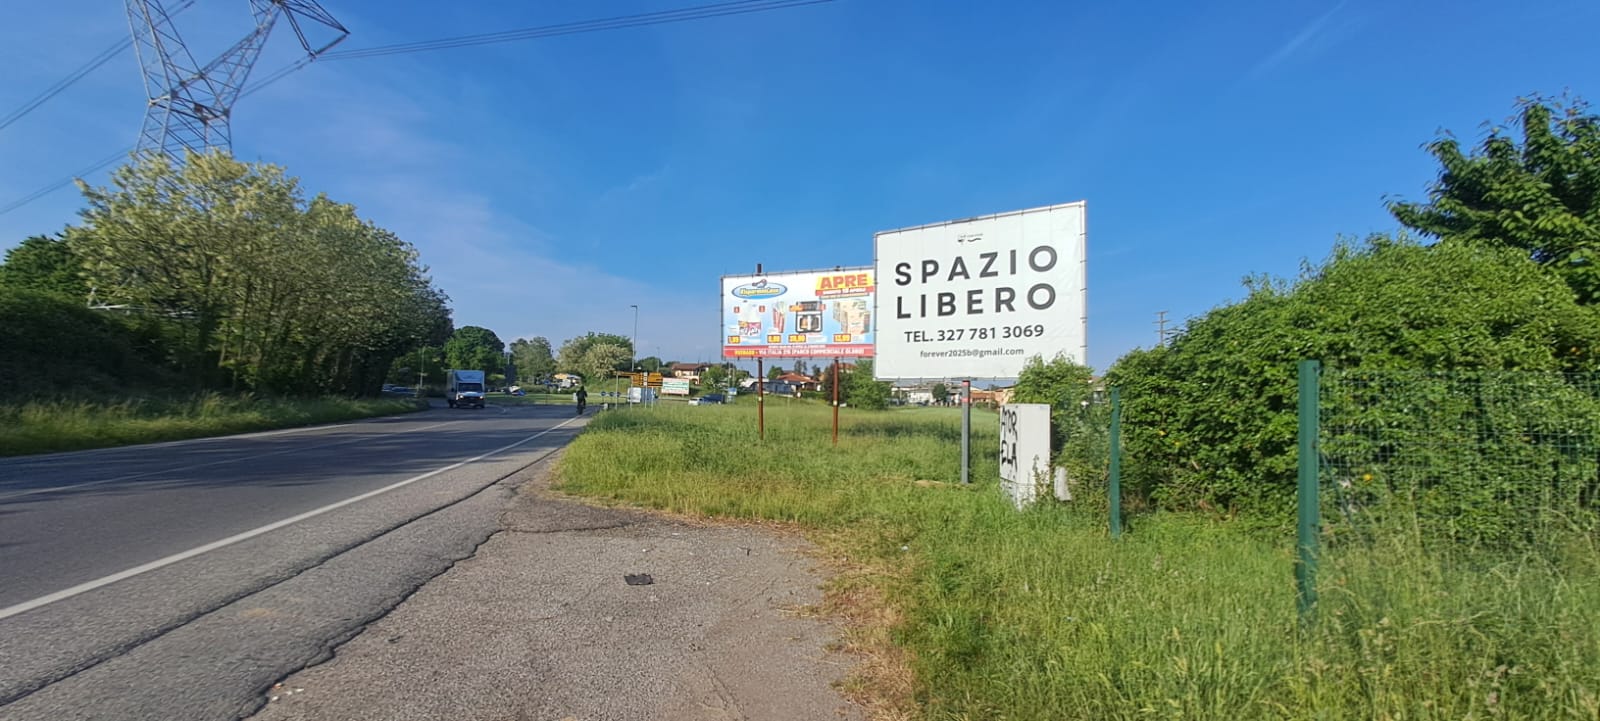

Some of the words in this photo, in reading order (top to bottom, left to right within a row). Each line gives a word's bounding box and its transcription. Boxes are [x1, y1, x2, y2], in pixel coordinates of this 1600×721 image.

[895, 245, 1058, 286] SPAZIO
[820, 273, 867, 289] APRE
[896, 283, 1056, 319] LIBERO
[904, 330, 934, 343] TEL.
[937, 329, 965, 342] 327
[969, 327, 996, 340] 781
[1002, 324, 1044, 339] 3069
[920, 347, 1024, 358] forever2025b@gmail.com
